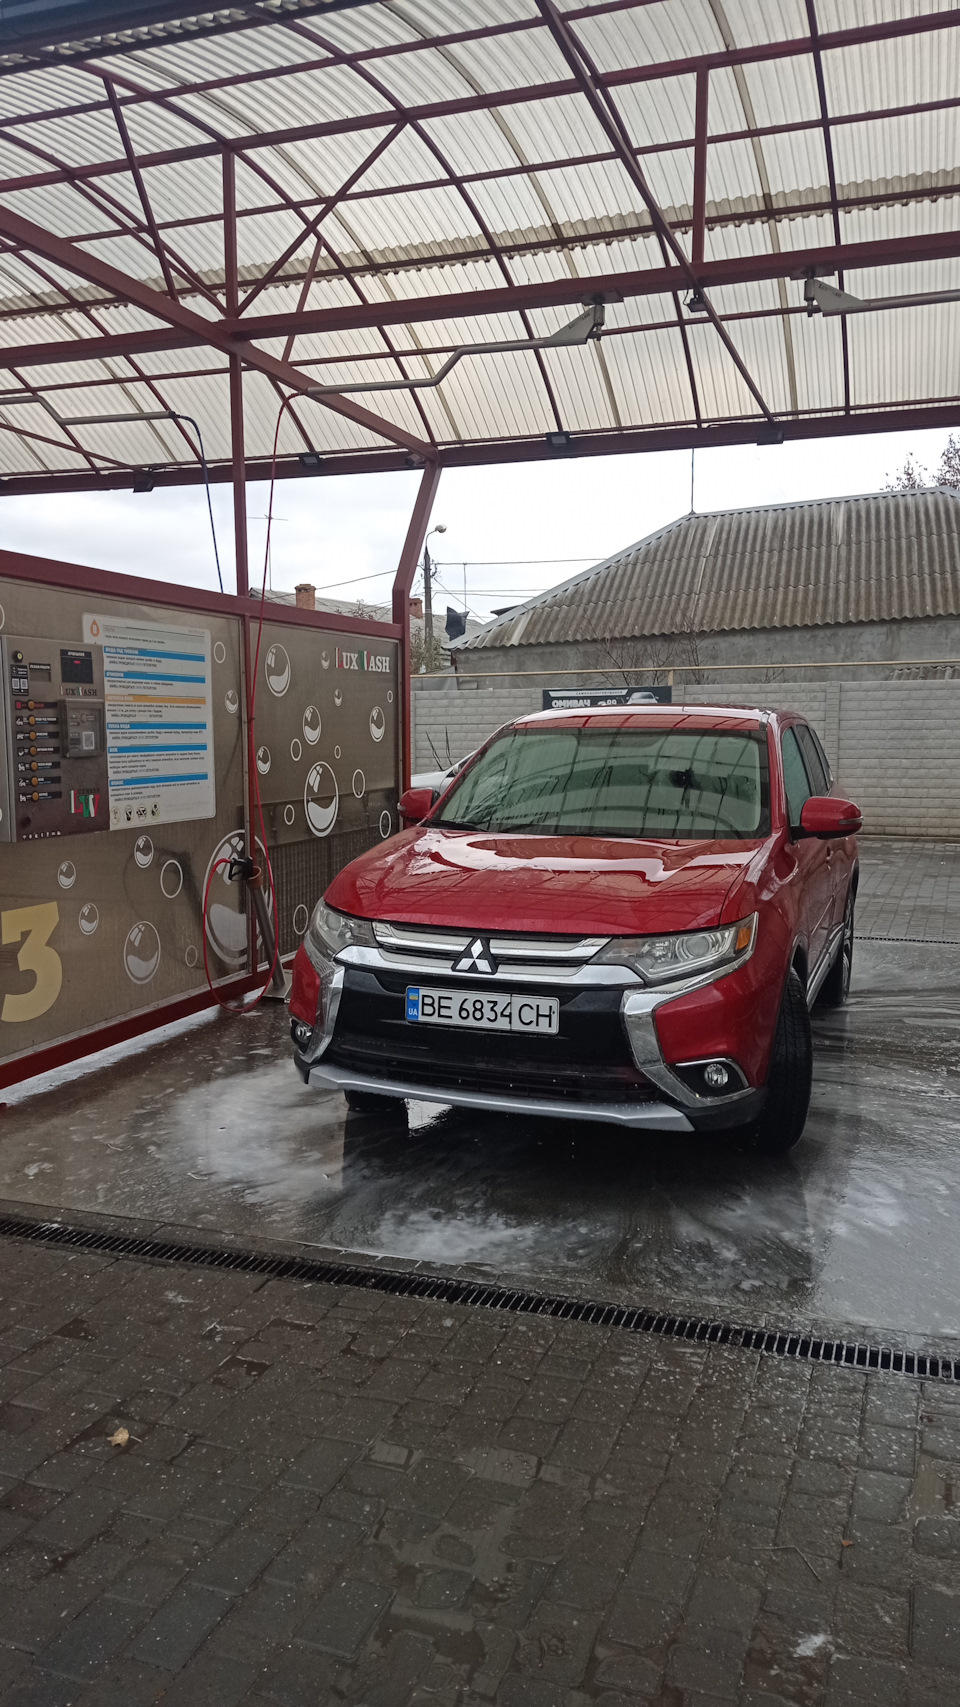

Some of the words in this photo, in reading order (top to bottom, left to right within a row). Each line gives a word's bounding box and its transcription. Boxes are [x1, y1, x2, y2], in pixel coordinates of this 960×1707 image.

[335, 647, 358, 670] LUX
[359, 650, 390, 673] WASH
[551, 699, 591, 708] ОМИВАЧ
[1, 901, 62, 1022] 3
[408, 1007, 418, 1016] UA
[421, 994, 453, 1020] BE
[458, 998, 512, 1025] 6834
[518, 1003, 553, 1028] CH
